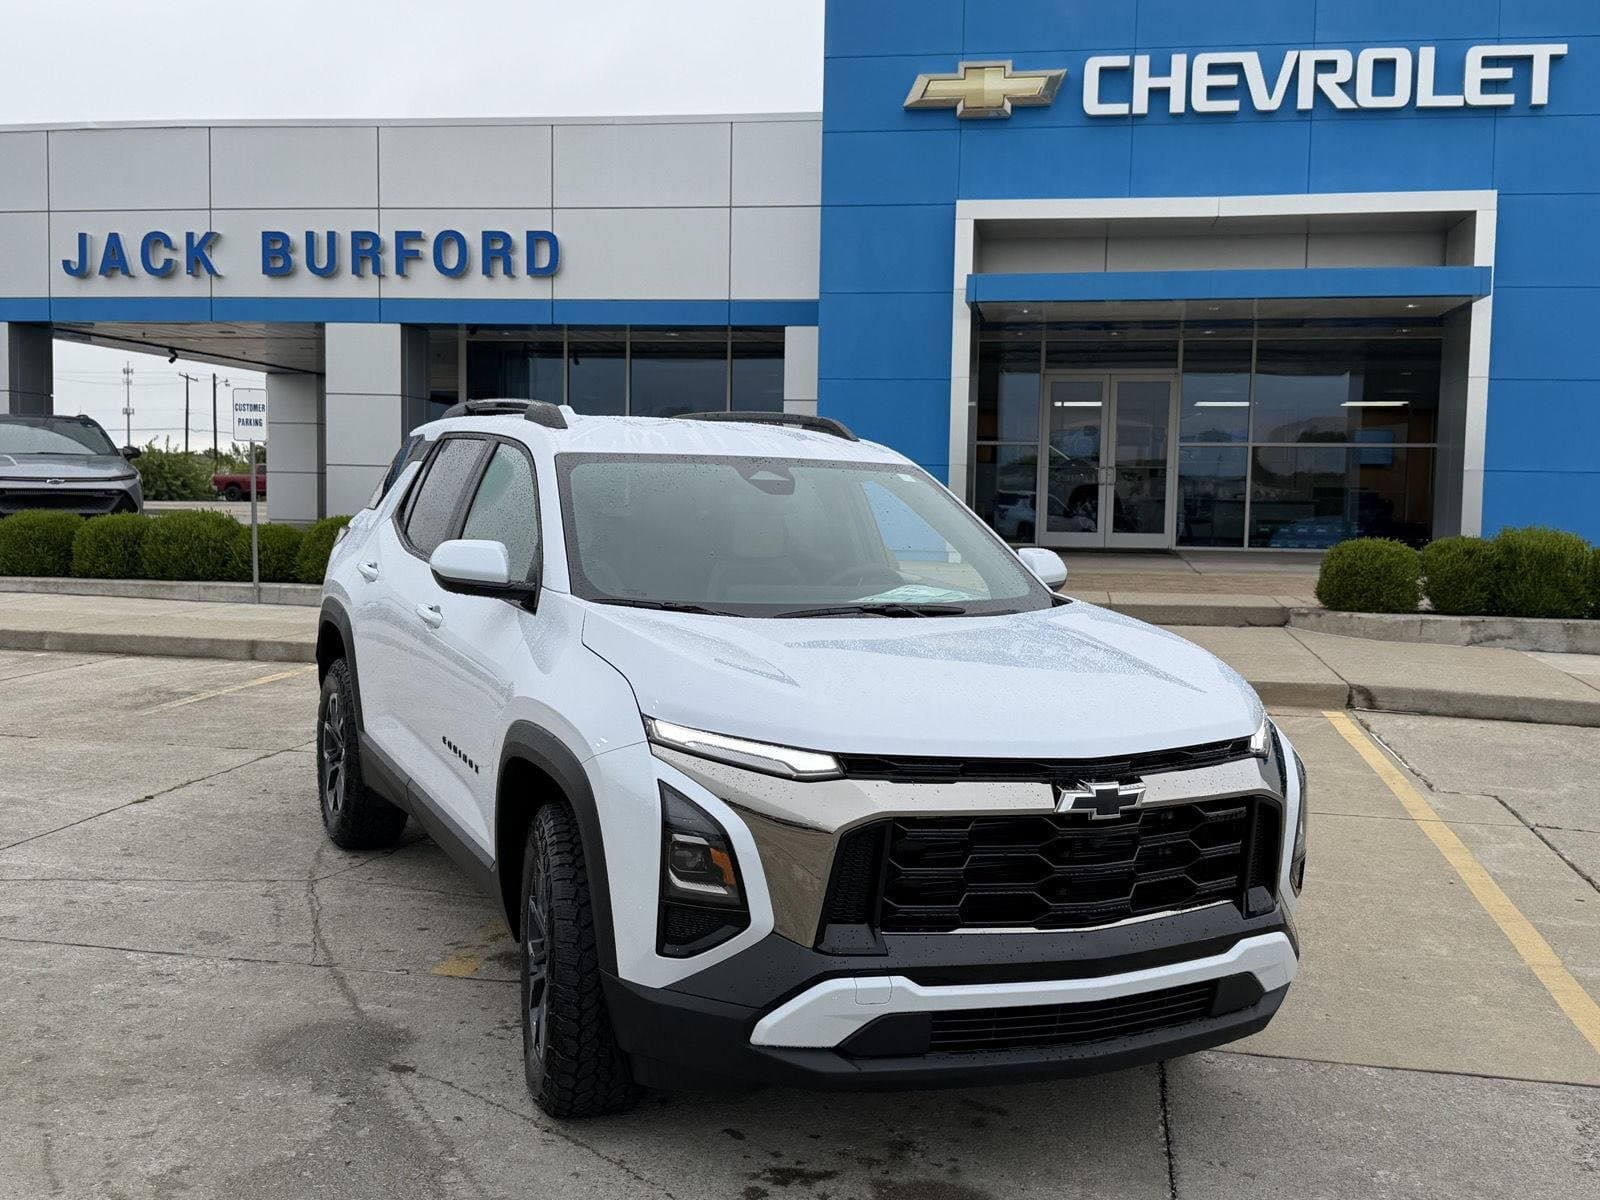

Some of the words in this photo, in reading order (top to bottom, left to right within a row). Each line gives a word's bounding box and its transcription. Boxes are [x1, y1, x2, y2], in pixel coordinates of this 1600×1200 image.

[1082, 43, 1568, 117] CHEVROLET
[62, 230, 221, 277] JACK
[261, 229, 561, 277] BURFORD
[234, 403, 266, 412] CUSTOMER
[237, 418, 263, 427] PARKING
